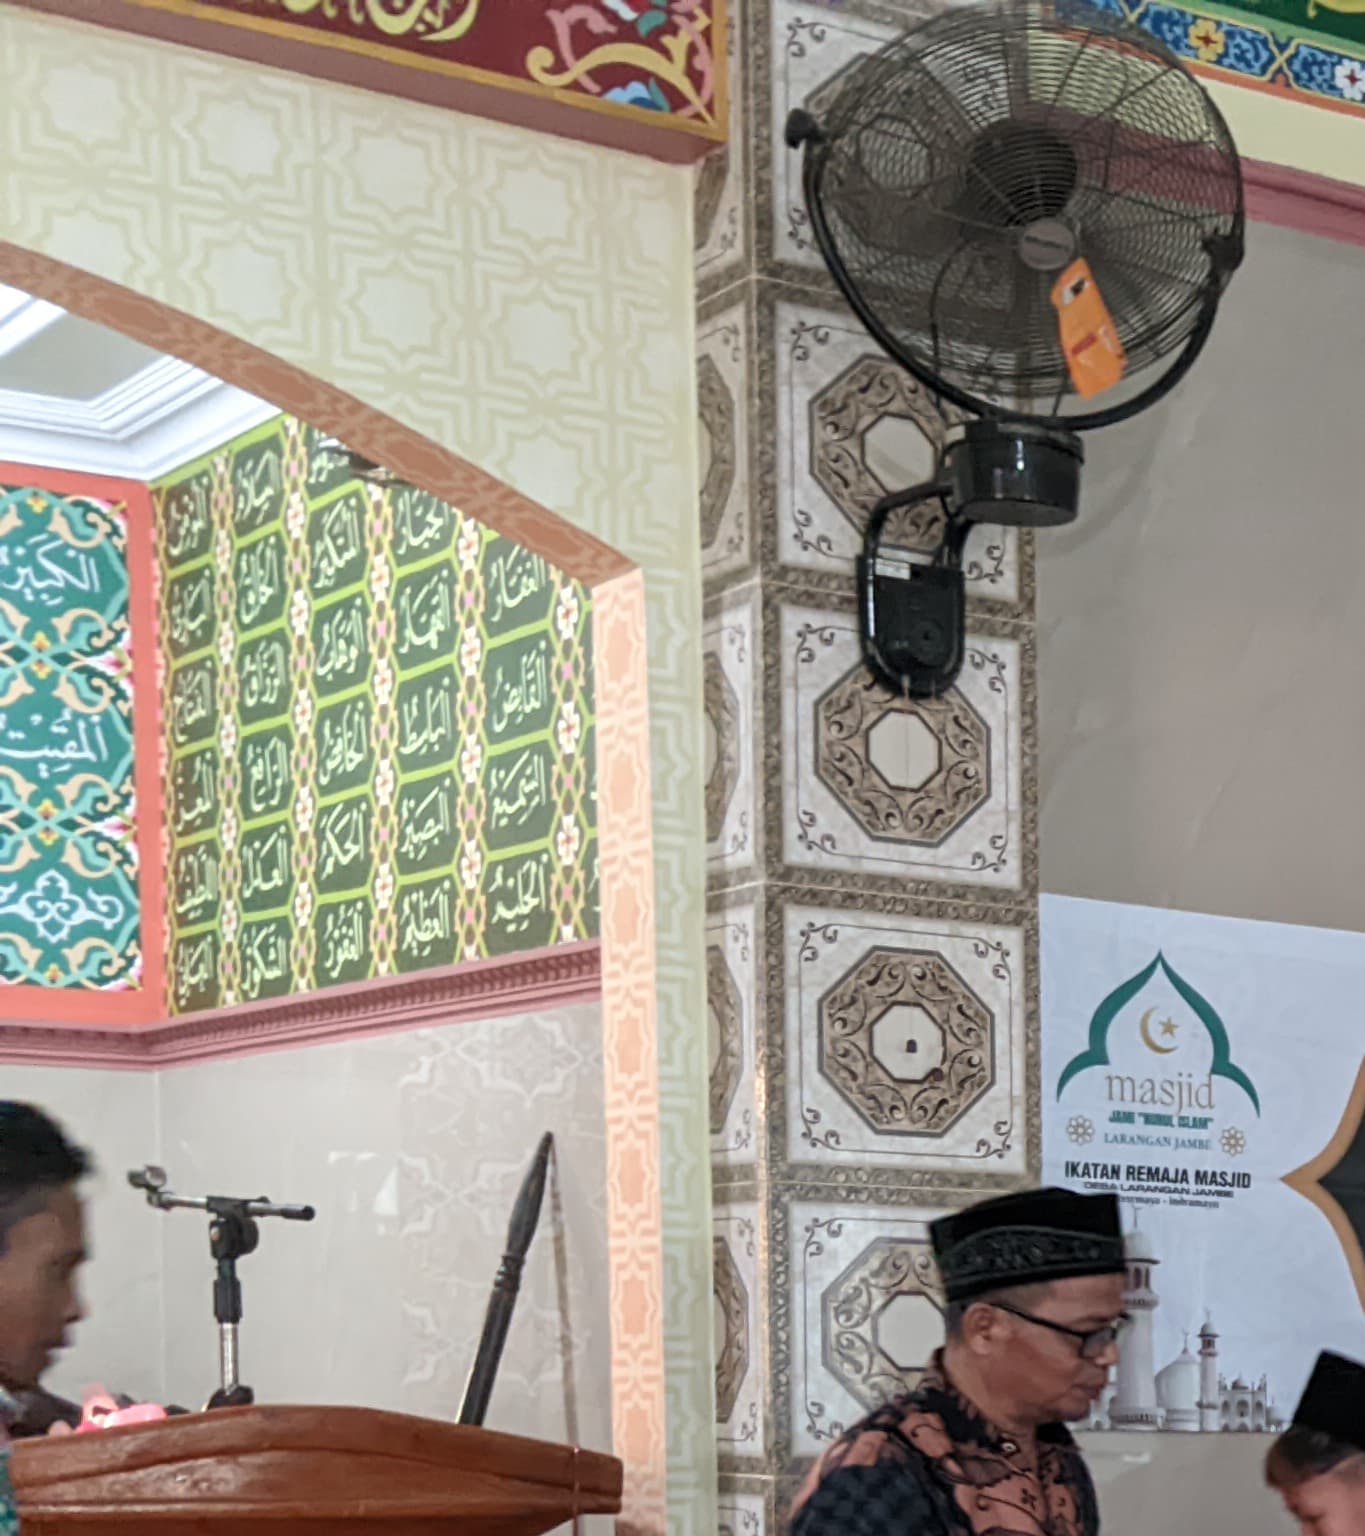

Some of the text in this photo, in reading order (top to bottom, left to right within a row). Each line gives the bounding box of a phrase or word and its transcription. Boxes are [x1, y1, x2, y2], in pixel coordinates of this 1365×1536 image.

[1104, 1071, 1215, 1116] masjid
[1065, 1160, 1251, 1189] IKATAN REMAJA MASJID
